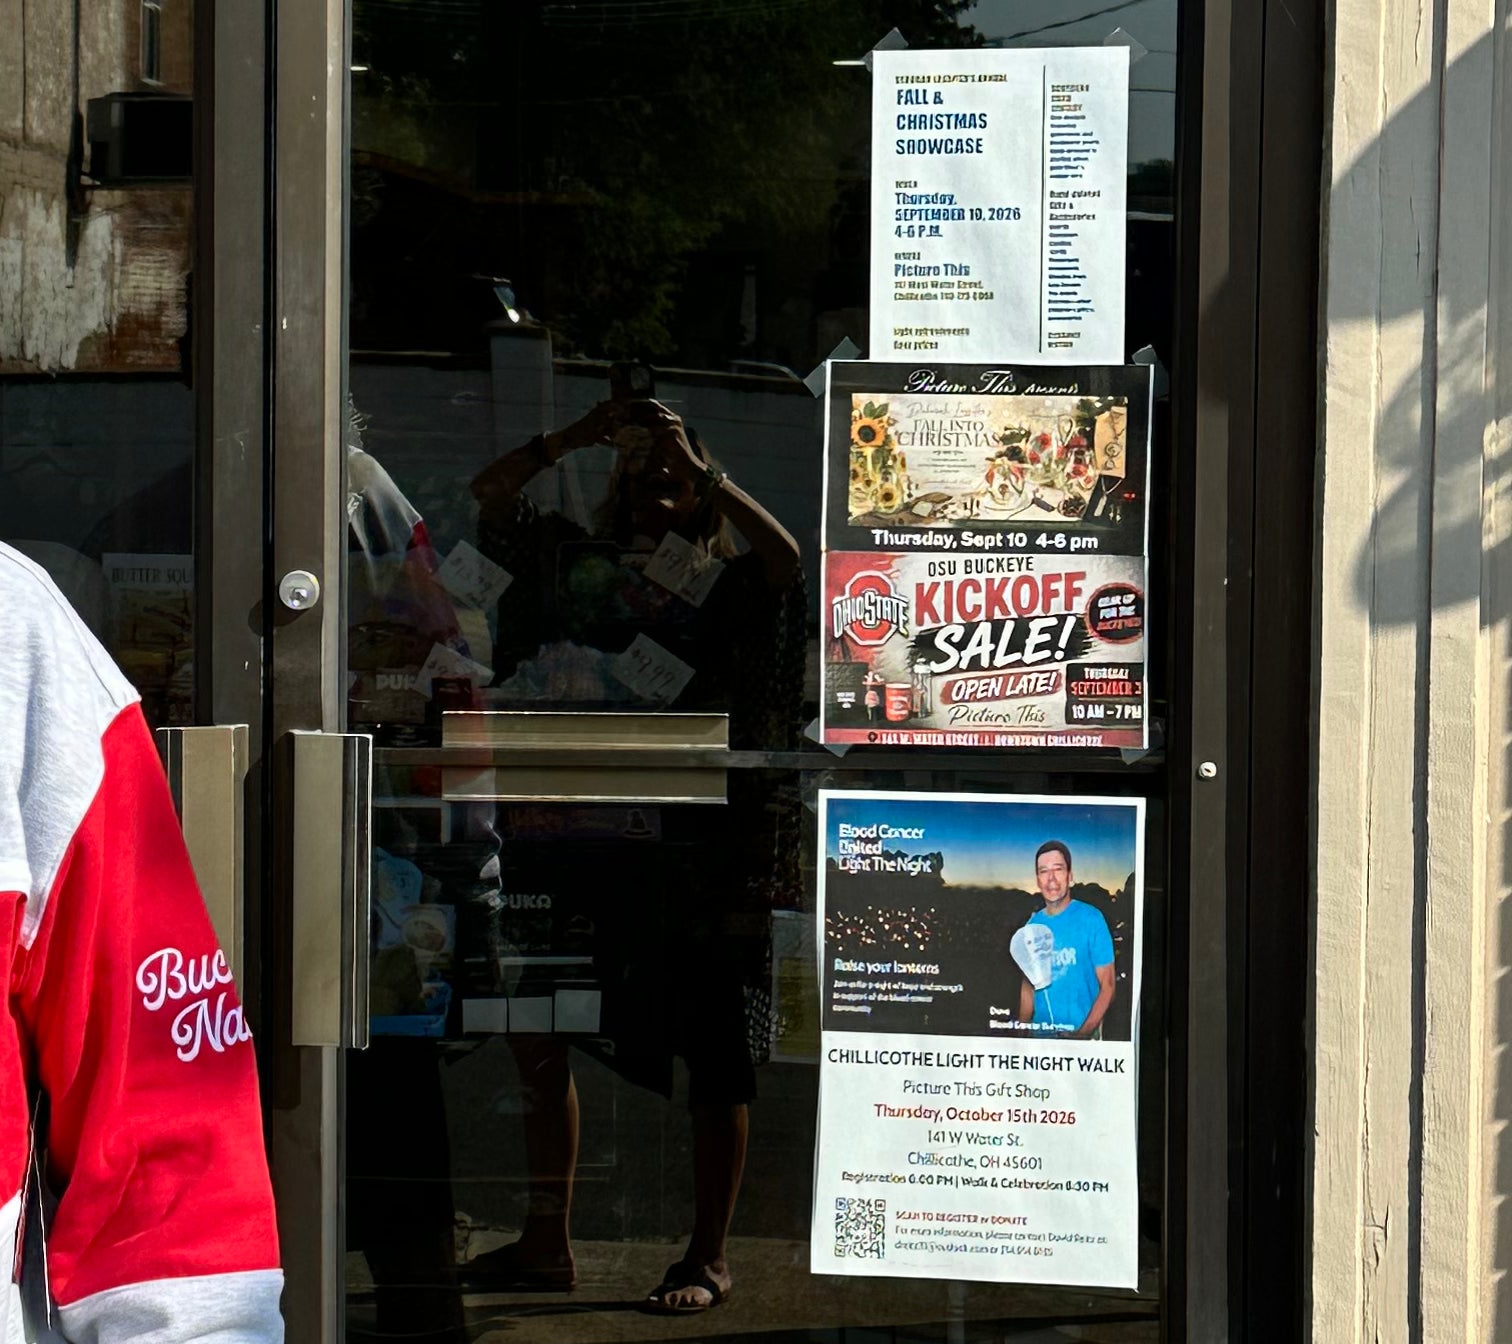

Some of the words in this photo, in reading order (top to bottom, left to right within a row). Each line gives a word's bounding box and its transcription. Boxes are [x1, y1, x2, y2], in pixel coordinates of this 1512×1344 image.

[897, 89, 929, 105] FALL
[897, 113, 988, 130] CHRISTMAS
[904, 369, 967, 393] Picture
[972, 370, 1017, 394] This
[914, 419, 947, 432] FALL
[950, 419, 985, 432] INTO
[897, 431, 1001, 448] CHRISTMAS
[871, 529, 957, 549] Thursday,
[961, 532, 1003, 550] Sept
[1007, 533, 1027, 548] 10
[1035, 533, 1067, 548] 4-6
[1070, 536, 1099, 551] pm
[928, 560, 957, 577] OSU
[964, 557, 1034, 574] BUCKEYE
[915, 571, 1086, 626] KICKOFF
[930, 615, 1077, 673] SALE!
[951, 677, 1000, 702] OPEN
[1005, 671, 1057, 696] LATE!
[947, 704, 1011, 725] Picture
[1016, 704, 1047, 724] This
[1072, 704, 1085, 719] 10
[1087, 704, 1104, 719] AM
[1115, 704, 1122, 719] 7
[1124, 704, 1142, 719] PM
[839, 824, 877, 838] Blood
[878, 824, 926, 839] Cancer
[839, 856, 871, 874] Light
[872, 856, 896, 871] The
[897, 857, 933, 876] Night
[828, 1049, 934, 1066] CHILLICOTHE
[936, 1053, 984, 1068] LIGHT
[988, 1055, 1020, 1070] THE
[1023, 1056, 1074, 1071] NIGHT
[1078, 1057, 1125, 1073] WALK
[903, 1080, 951, 1095] Picture
[954, 1082, 982, 1096] This
[986, 1083, 1011, 1097] Gift
[1015, 1084, 1050, 1101] Shop
[874, 1104, 943, 1123] Thursday,
[946, 1107, 1003, 1122] October
[1007, 1109, 1037, 1123] 15th
[1040, 1110, 1076, 1124] 2026
[928, 1130, 945, 1143] 141
[949, 1131, 962, 1144] W
[966, 1132, 1003, 1145] Water
[980, 1155, 1000, 1168] OH
